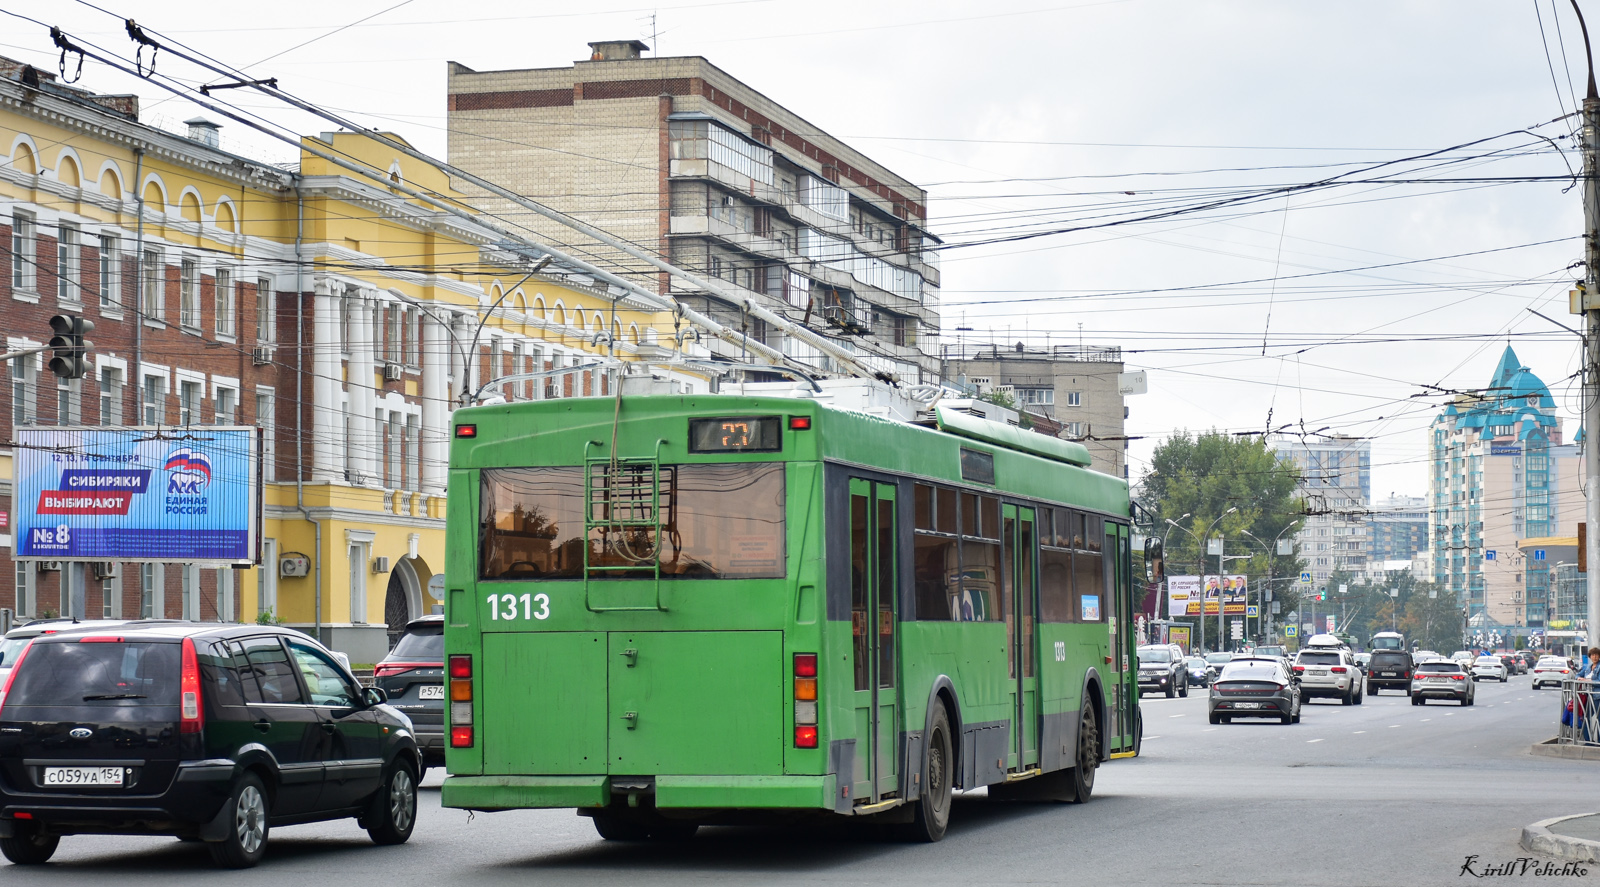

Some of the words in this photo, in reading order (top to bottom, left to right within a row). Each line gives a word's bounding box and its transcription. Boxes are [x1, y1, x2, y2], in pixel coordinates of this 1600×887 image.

[52, 454, 63, 463] 12,
[66, 454, 78, 463] 13,
[80, 454, 90, 462] 14
[92, 454, 139, 463] СЕНТЯБРЯ
[68, 476, 141, 487] СИБИРЯКИ
[44, 497, 124, 508] ВЫБИРАЮТ
[165, 496, 207, 505] ЕДИНАЯ
[165, 506, 207, 515] РОССИЯ
[56, 524, 70, 544] 8
[486, 593, 551, 621] 1313
[1054, 641, 1066, 662] 1313
[101, 768, 121, 779] 154
